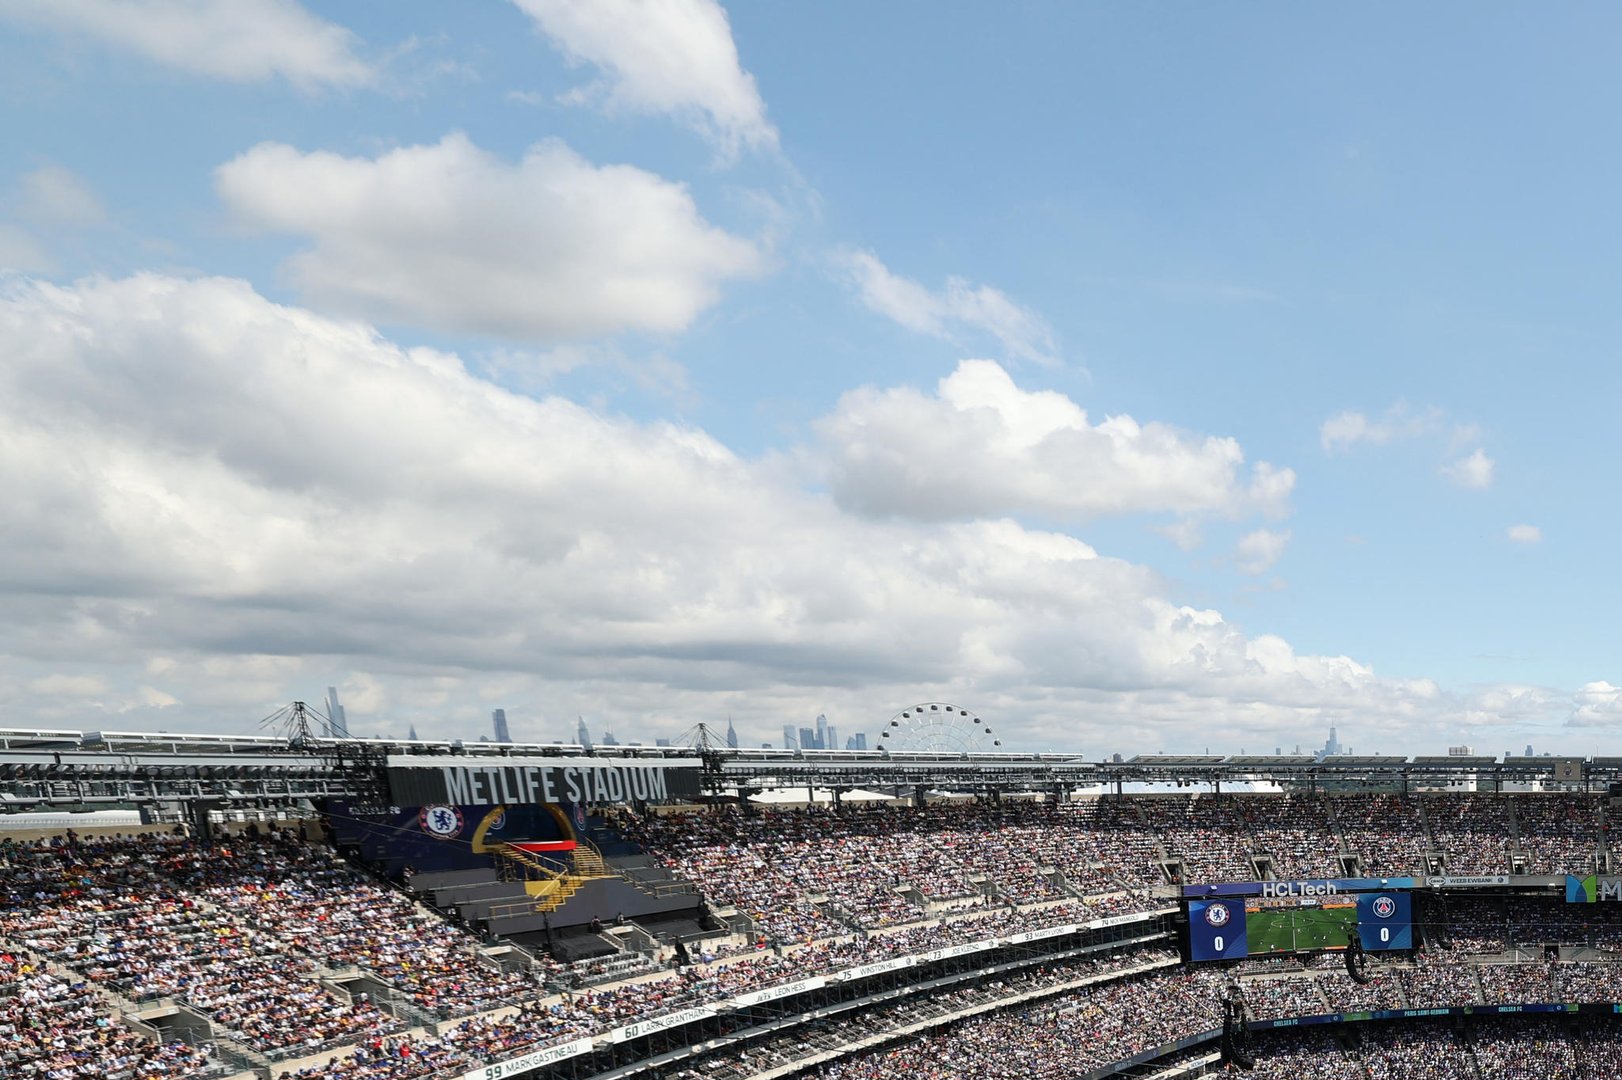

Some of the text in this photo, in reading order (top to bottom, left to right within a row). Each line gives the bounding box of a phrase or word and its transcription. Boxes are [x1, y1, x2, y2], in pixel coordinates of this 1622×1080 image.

[442, 766, 668, 805] METLIFE STADIUM
[1262, 881, 1337, 897] HCLTech
[1025, 932, 1034, 941] 93
[1380, 927, 1390, 942] 0
[1214, 936, 1224, 951] 0
[932, 951, 942, 960] 73
[951, 946, 961, 955] JOE
[842, 960, 897, 981] 75 WINSTON HILL
[774, 986, 791, 997] LEON
[791, 982, 806, 993] HESS
[1417, 1008, 1449, 1016] SAINT-GERMAIN
[625, 1008, 706, 1039] 60 LARRY GRANTHAM
[485, 1044, 578, 1080] 99 MARK GASTINEAU
